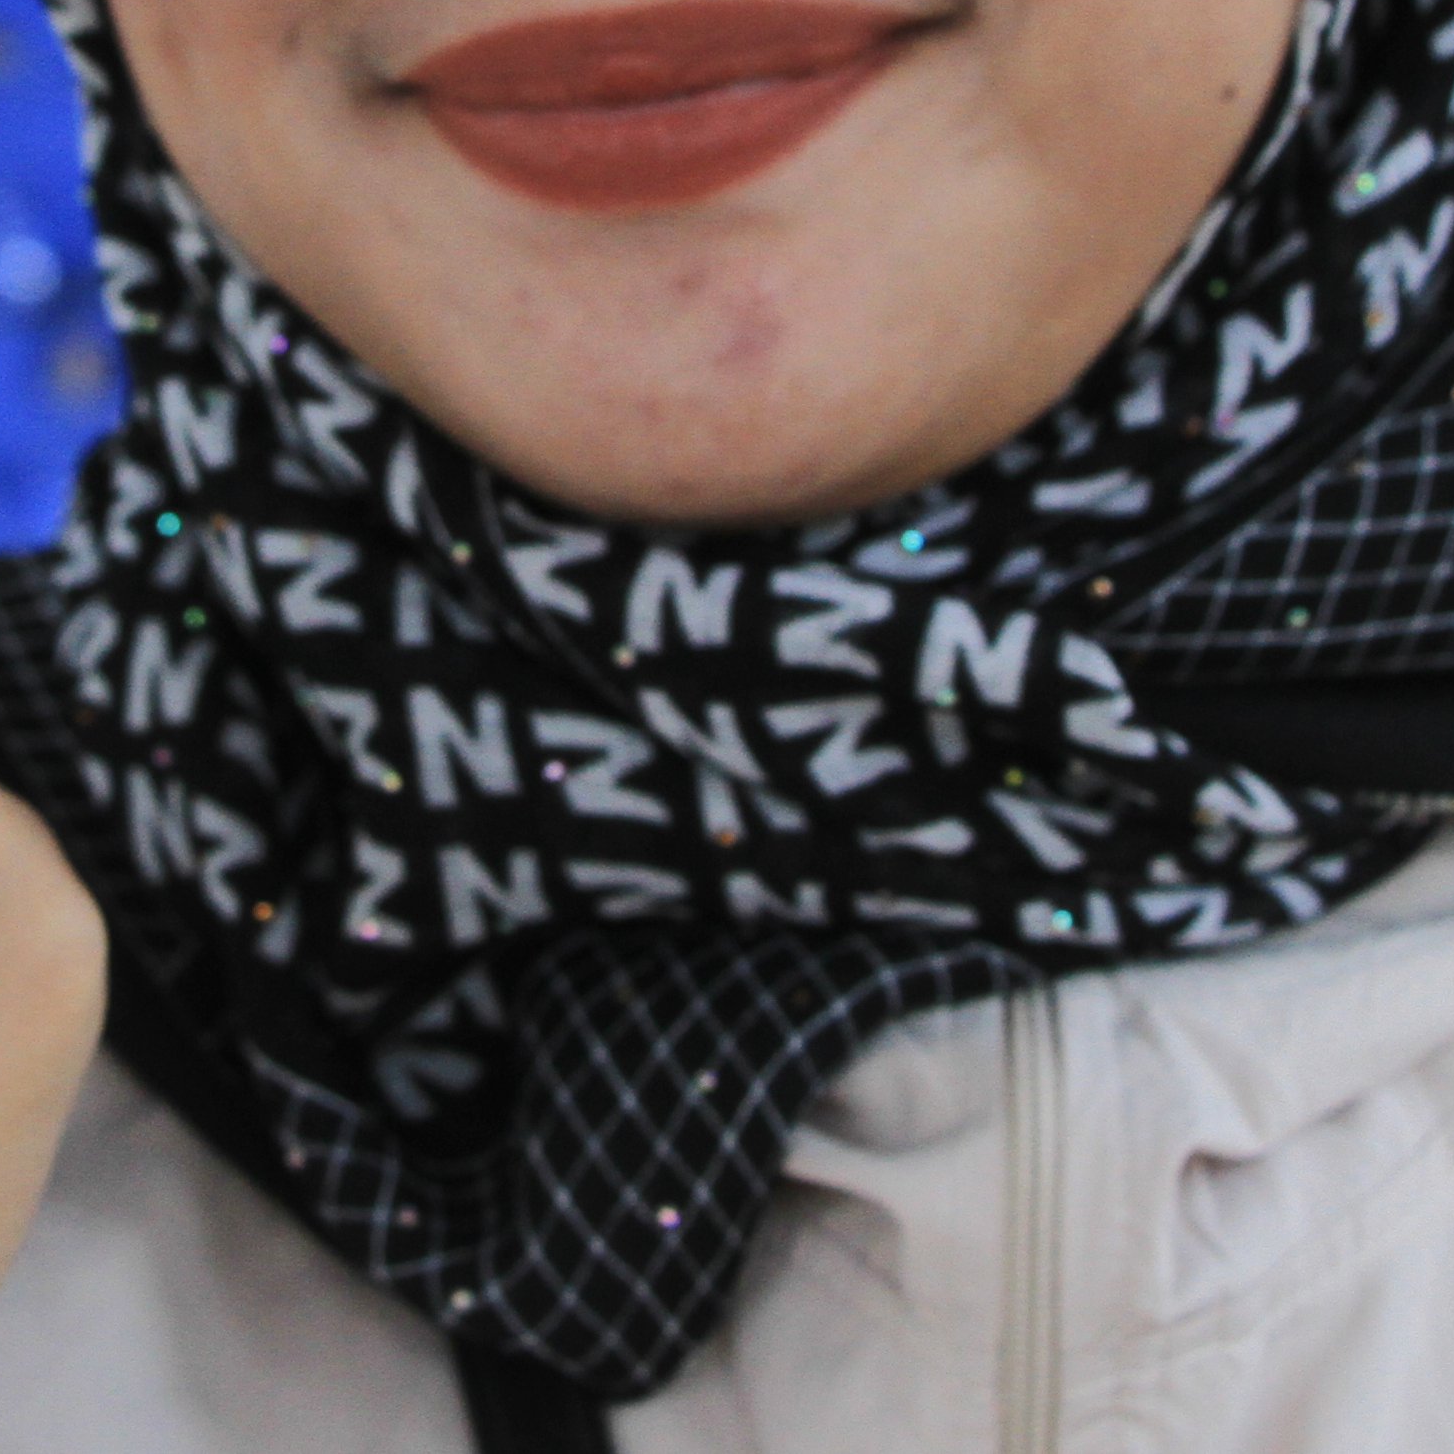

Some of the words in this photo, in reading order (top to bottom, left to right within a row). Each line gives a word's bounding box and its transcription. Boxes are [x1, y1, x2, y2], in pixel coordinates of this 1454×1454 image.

[624, 546, 742, 654] N
[916, 599, 1034, 706] N
[408, 686, 519, 808] N
